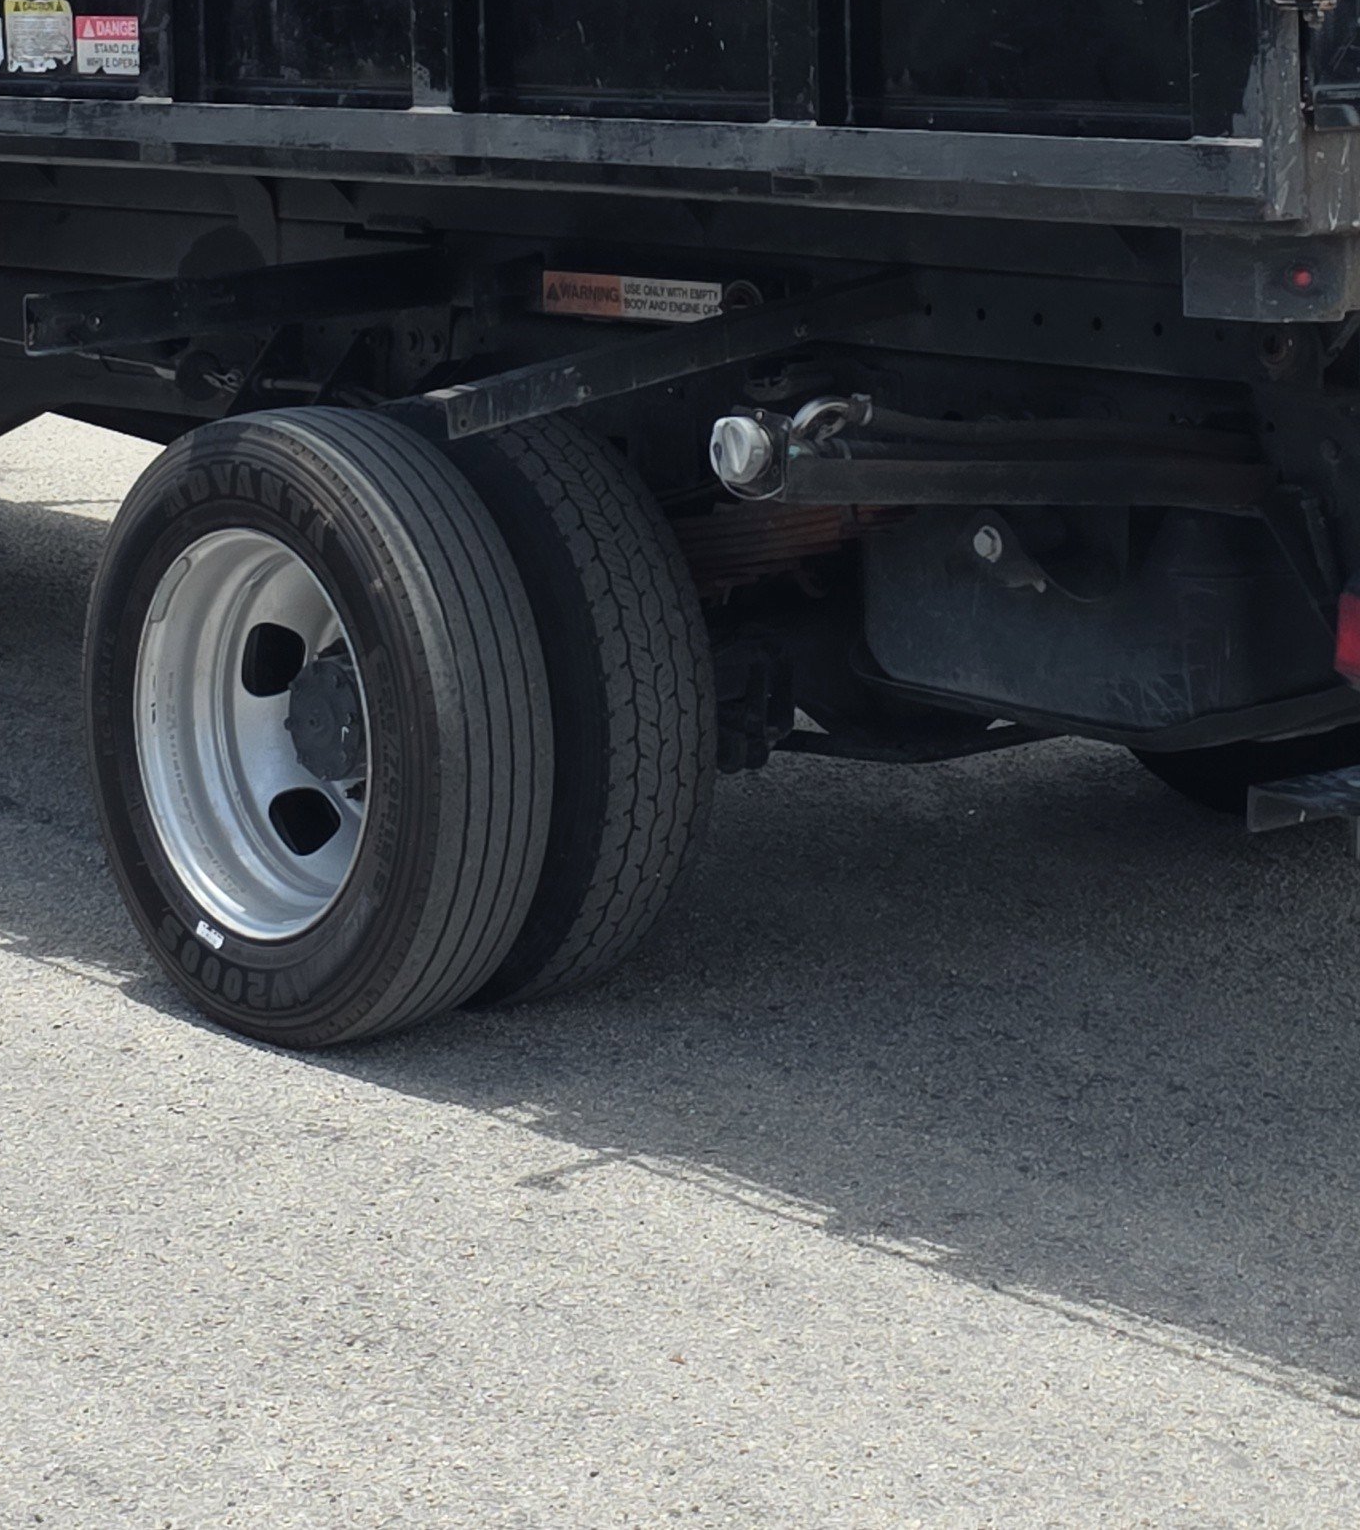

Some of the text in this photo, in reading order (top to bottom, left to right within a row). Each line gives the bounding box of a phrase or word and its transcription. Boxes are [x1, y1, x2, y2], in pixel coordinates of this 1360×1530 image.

[96, 21, 138, 37] DANGE
[559, 281, 620, 303] WARNING
[623, 283, 718, 301] USE ONLY WITH EMPTY
[624, 298, 648, 310] BODY
[649, 301, 667, 312] AND
[669, 302, 700, 314] ENGINE
[164, 459, 332, 553] ADVANTA
